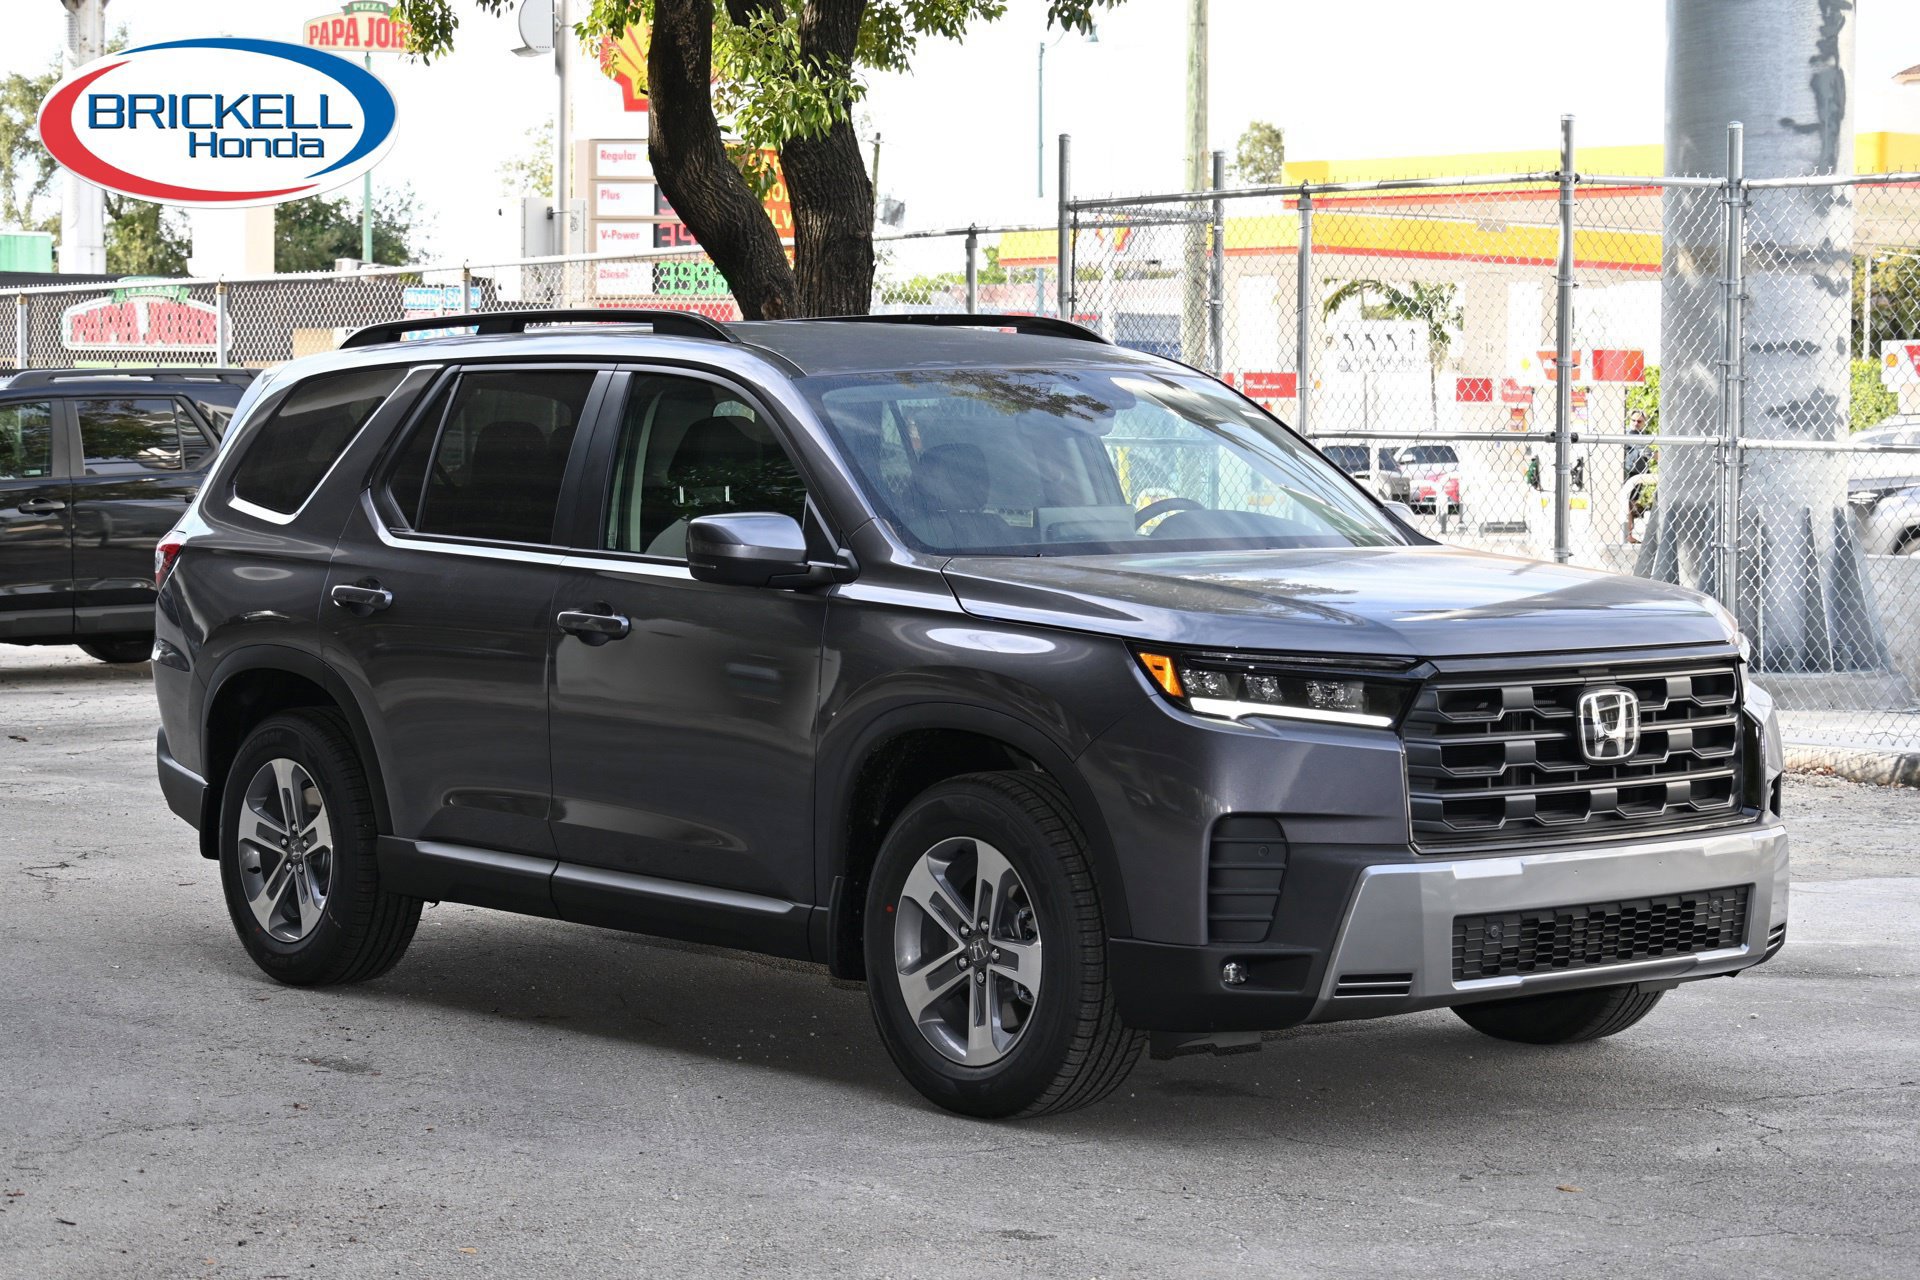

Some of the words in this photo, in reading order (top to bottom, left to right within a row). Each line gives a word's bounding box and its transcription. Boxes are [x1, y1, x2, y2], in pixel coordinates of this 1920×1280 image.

[352, 3, 384, 12] PIZZA
[309, 18, 360, 46] PAPA
[364, 17, 413, 48] JOH
[600, 149, 637, 163] Regular
[600, 189, 621, 200] Plus
[600, 229, 641, 241] V-Power
